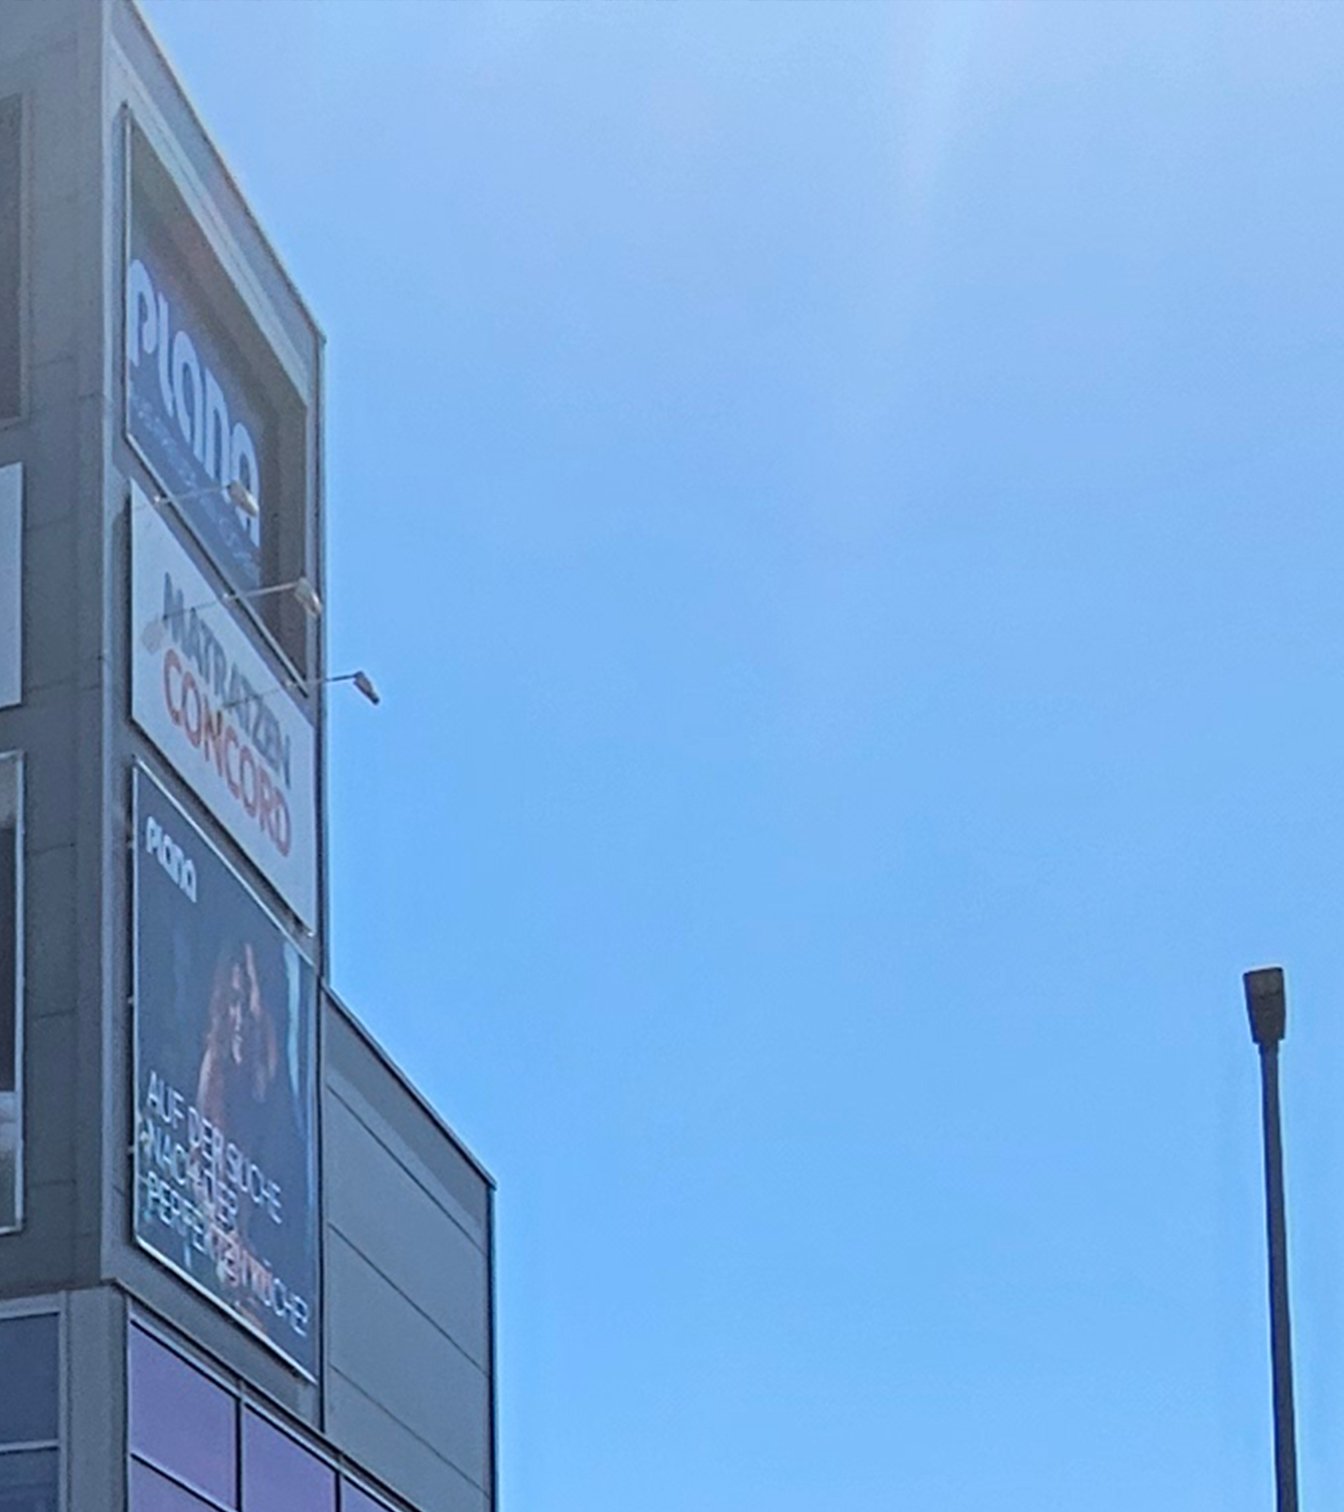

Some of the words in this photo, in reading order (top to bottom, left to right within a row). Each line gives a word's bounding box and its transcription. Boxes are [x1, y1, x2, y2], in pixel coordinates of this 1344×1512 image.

[162, 571, 292, 790] MATRATZEN
[162, 648, 292, 858] CONCORD
[146, 1070, 185, 1128] AUF
